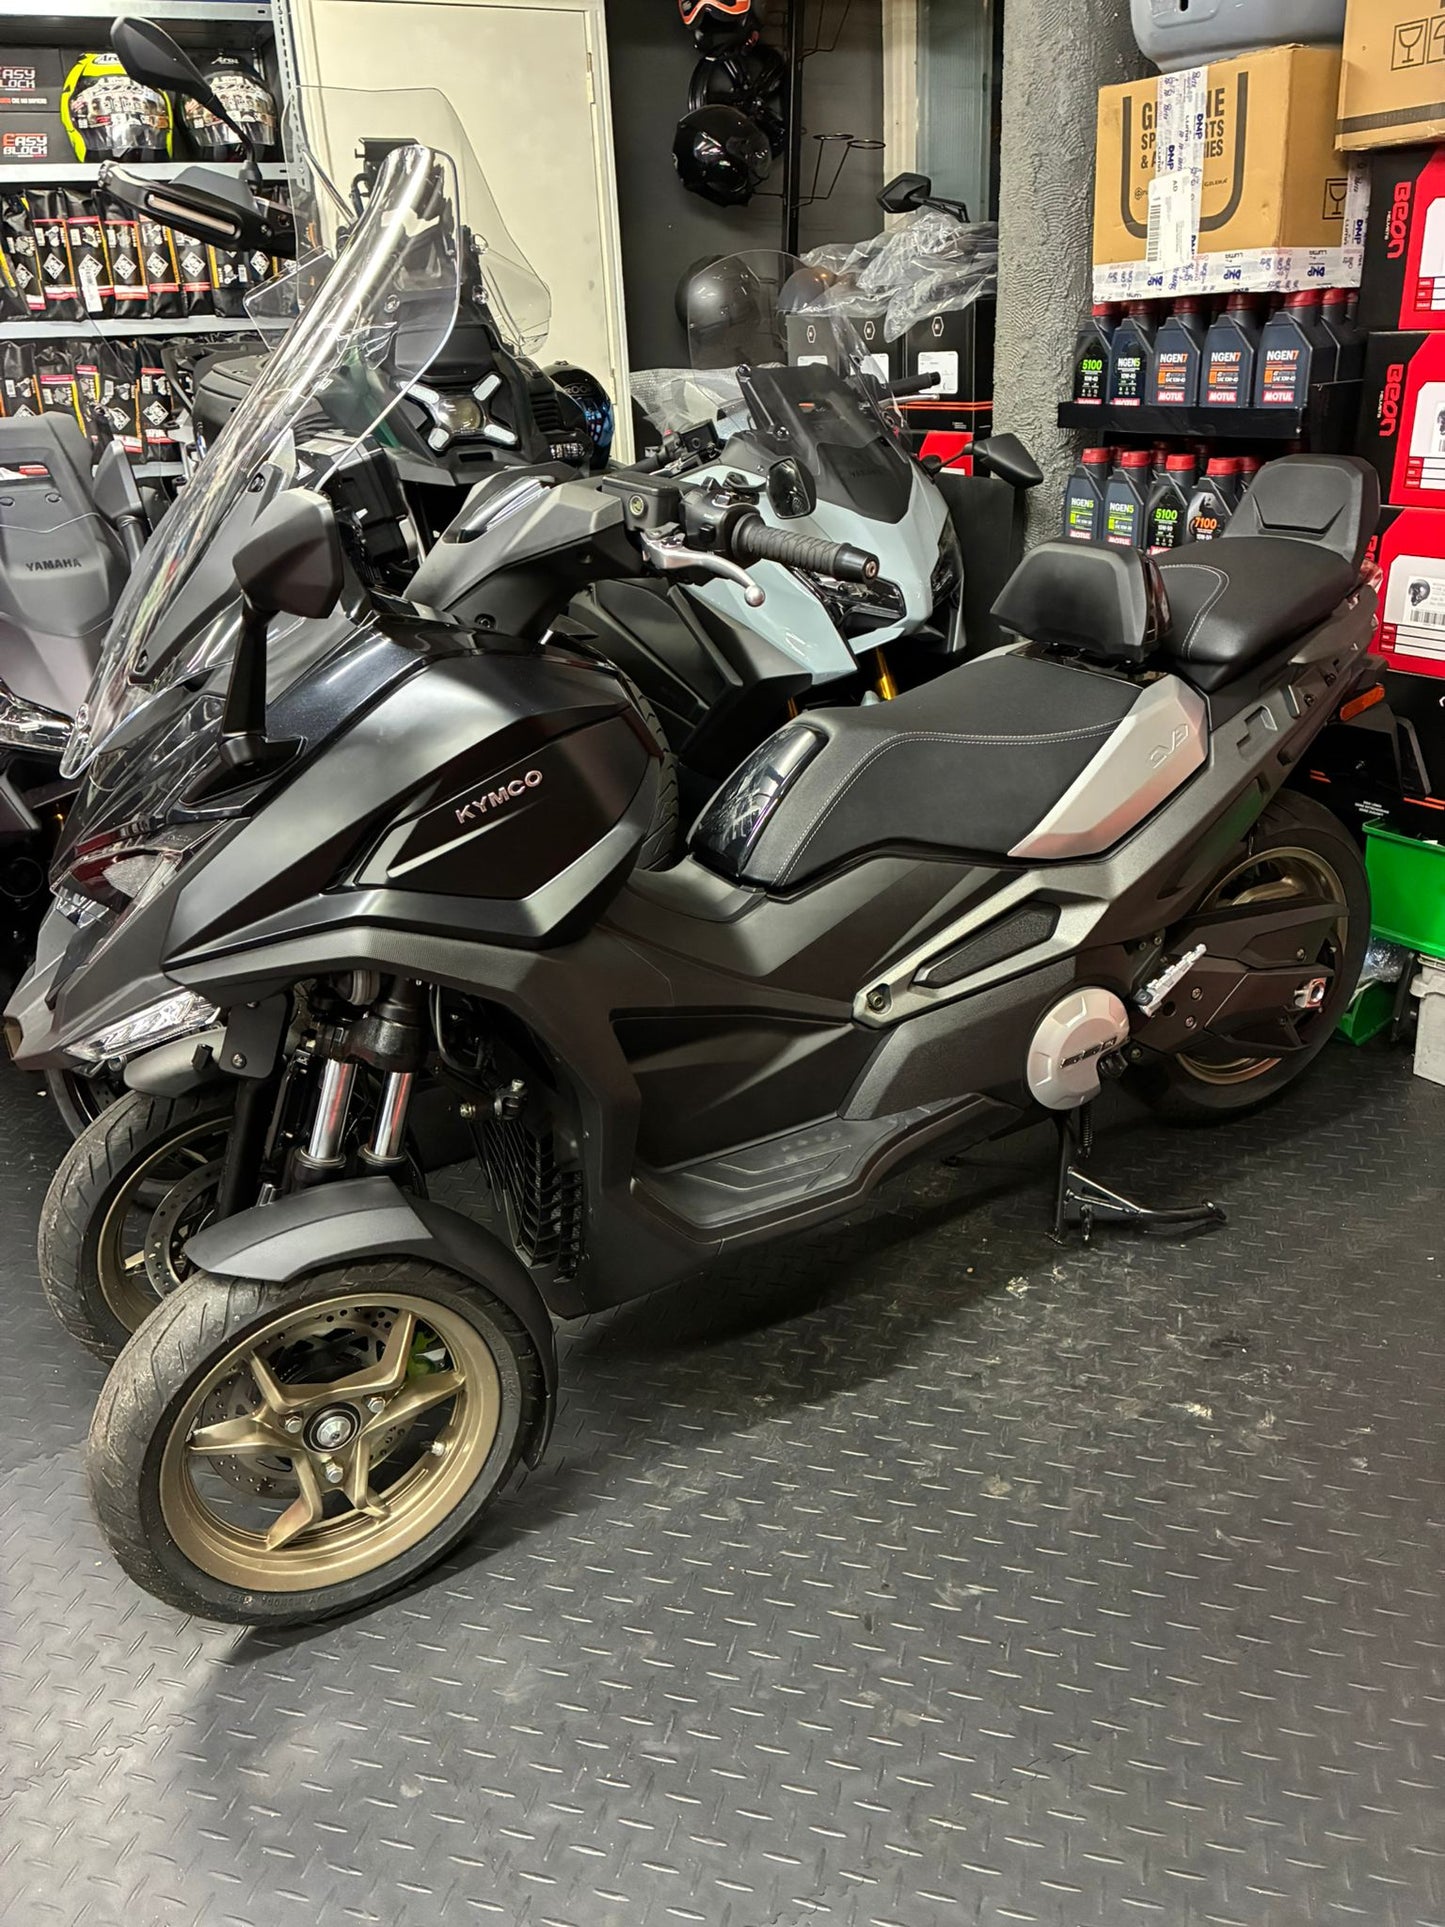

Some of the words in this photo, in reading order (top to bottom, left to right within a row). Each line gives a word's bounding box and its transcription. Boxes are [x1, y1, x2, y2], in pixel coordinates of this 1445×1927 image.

[0, 66, 35, 79] ASY
[0, 80, 35, 88] LOCK
[3, 133, 47, 146] EASY
[3, 146, 47, 155] BLOCK
[1160, 353, 1188, 363] NGEN7
[1211, 352, 1241, 362] NGEN7
[1267, 350, 1299, 361] NGEN7
[1082, 359, 1102, 370] 5100
[1118, 358, 1140, 368] NGEN5
[1158, 391, 1184, 402] MOTUL
[1208, 392, 1236, 402] MOTUL
[1264, 392, 1293, 402] MOTUL
[1071, 497, 1094, 508] NGEN5
[1109, 502, 1134, 514] NGEN5
[1155, 508, 1178, 520] 5100
[1195, 517, 1217, 530] 7100
[26, 558, 82, 572] YAMAHA
[455, 770, 543, 824] KYMCO
